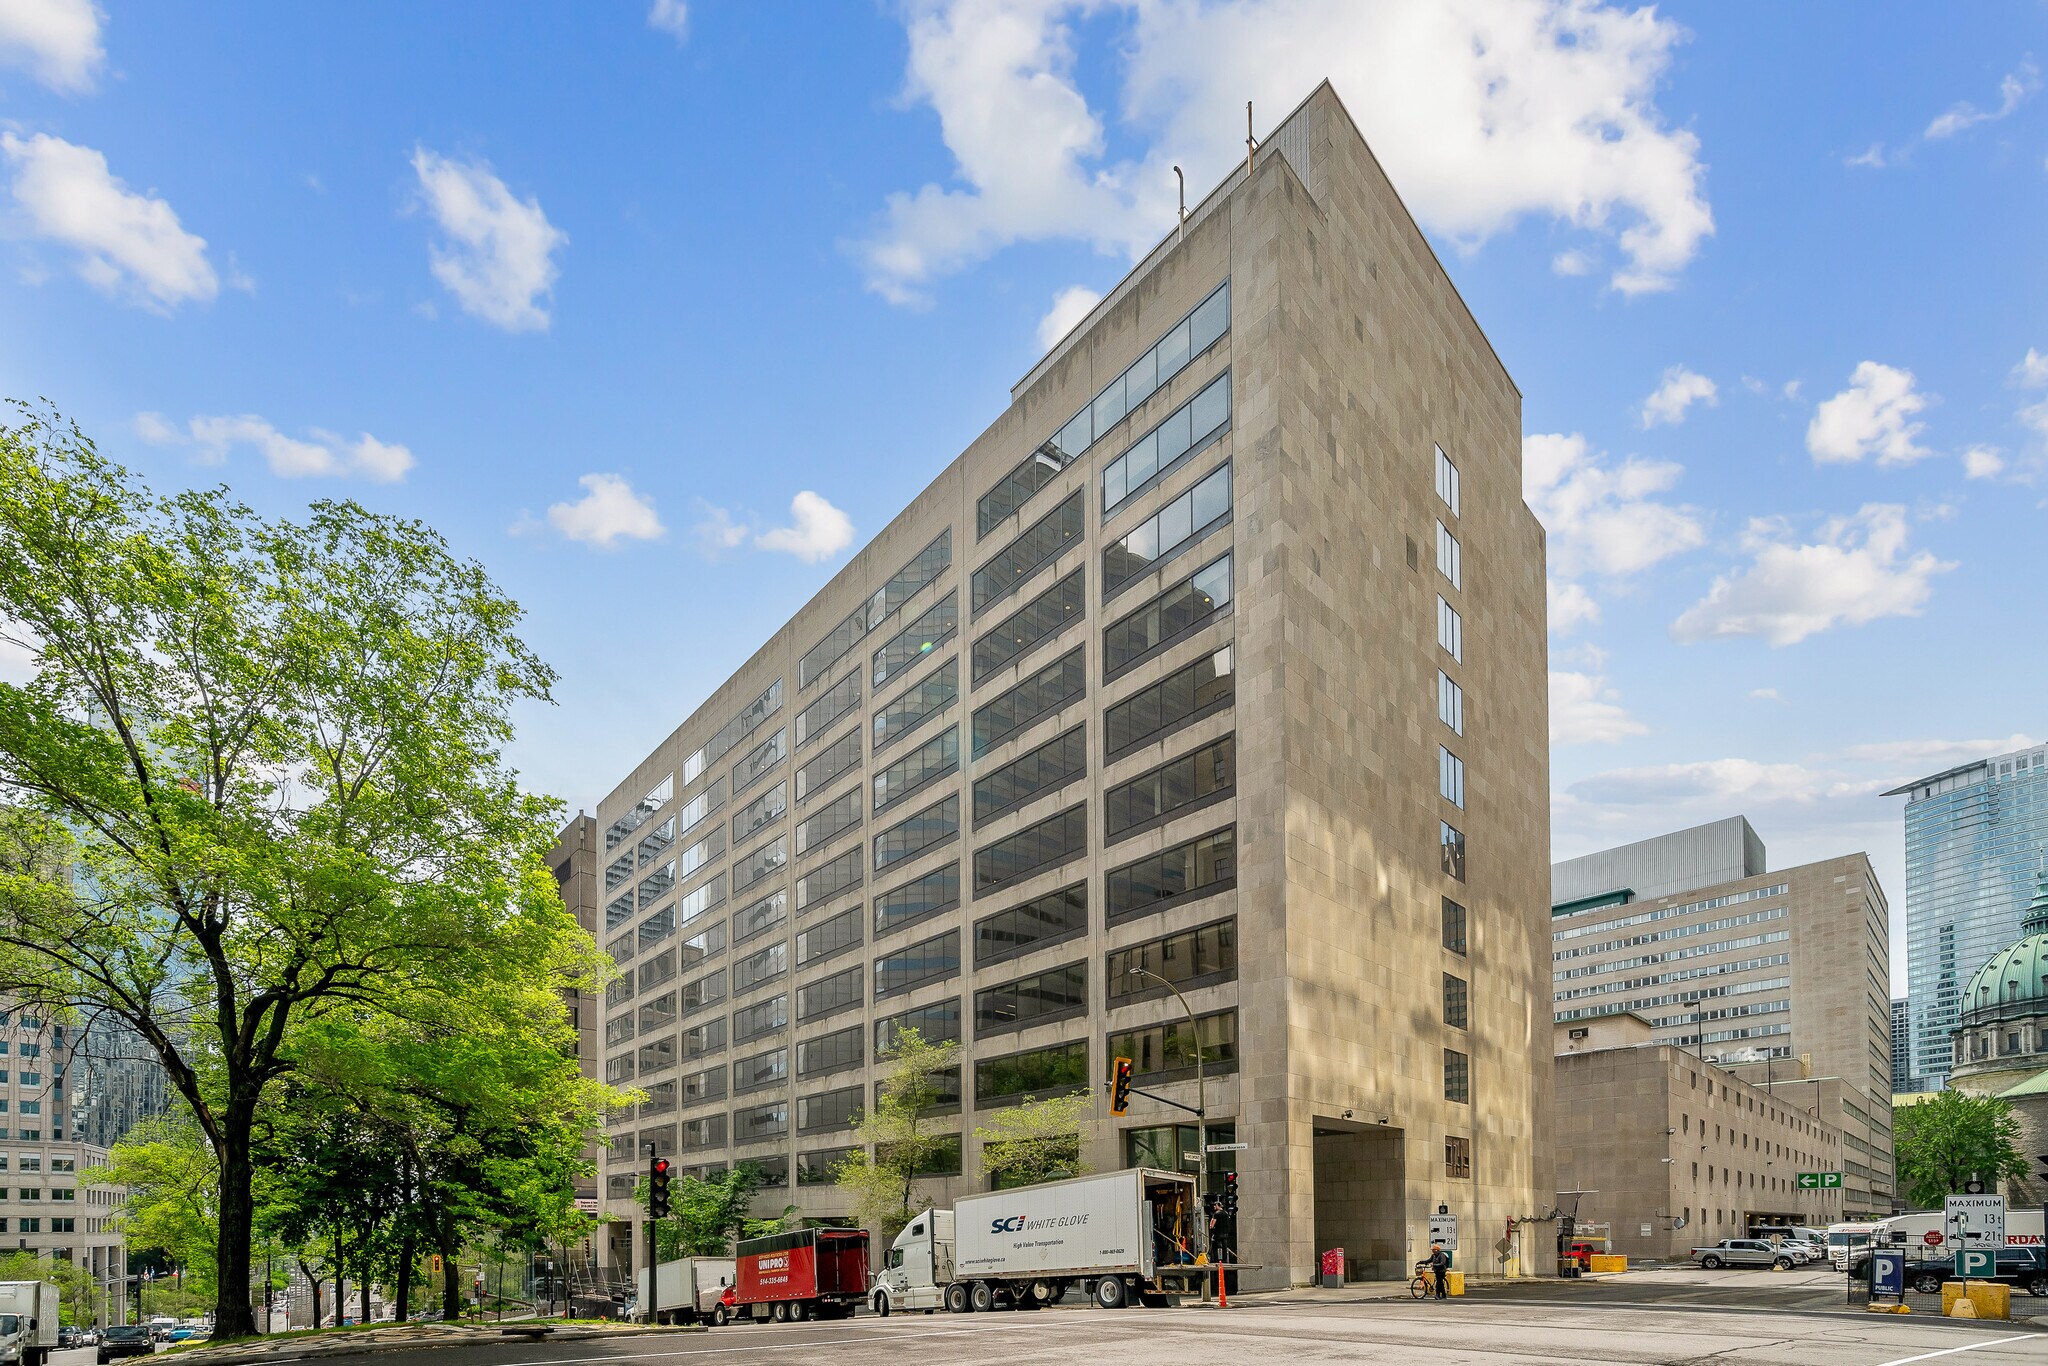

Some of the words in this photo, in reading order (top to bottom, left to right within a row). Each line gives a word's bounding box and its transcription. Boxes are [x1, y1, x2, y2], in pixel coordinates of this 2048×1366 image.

[1825, 1174, 1837, 1187] P
[1026, 1218, 1056, 1230] WHITE
[1058, 1214, 1089, 1227] GLOVE
[1984, 1214, 1995, 1224] 13
[1984, 1231, 1995, 1241] 21
[1034, 1239, 1064, 1248] Transportation
[1965, 1252, 1987, 1274] P
[1875, 1259, 1894, 1283] P
